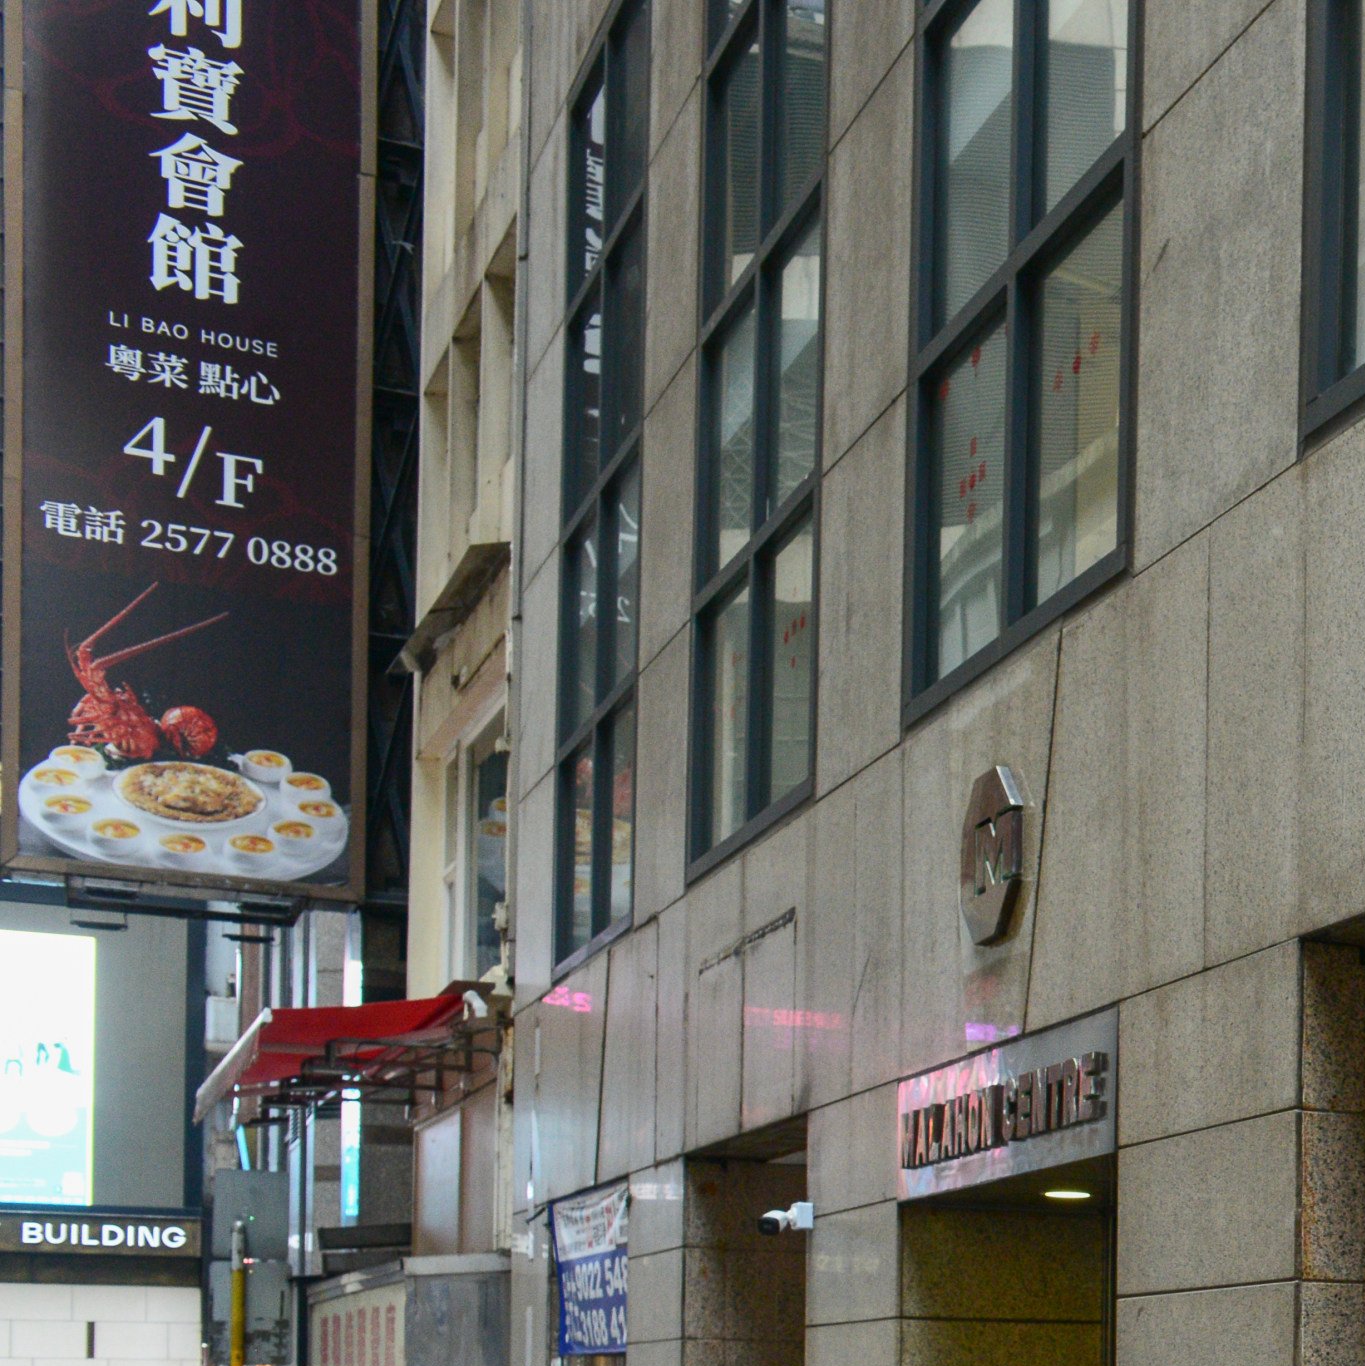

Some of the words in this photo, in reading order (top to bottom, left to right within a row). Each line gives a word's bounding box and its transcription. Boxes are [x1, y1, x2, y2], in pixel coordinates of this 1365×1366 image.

[109, 311, 131, 328] LI
[142, 318, 189, 340] BAO
[201, 330, 279, 358] HOUSE
[105, 342, 189, 391] 粵菜
[198, 360, 281, 409] 點心
[123, 416, 263, 508] 4/F
[40, 500, 127, 546] 電話
[141, 519, 235, 559] 2577
[247, 537, 338, 576] 0888
[1001, 1051, 1105, 1143] CENTRE
[21, 1221, 187, 1249] BUILDING
